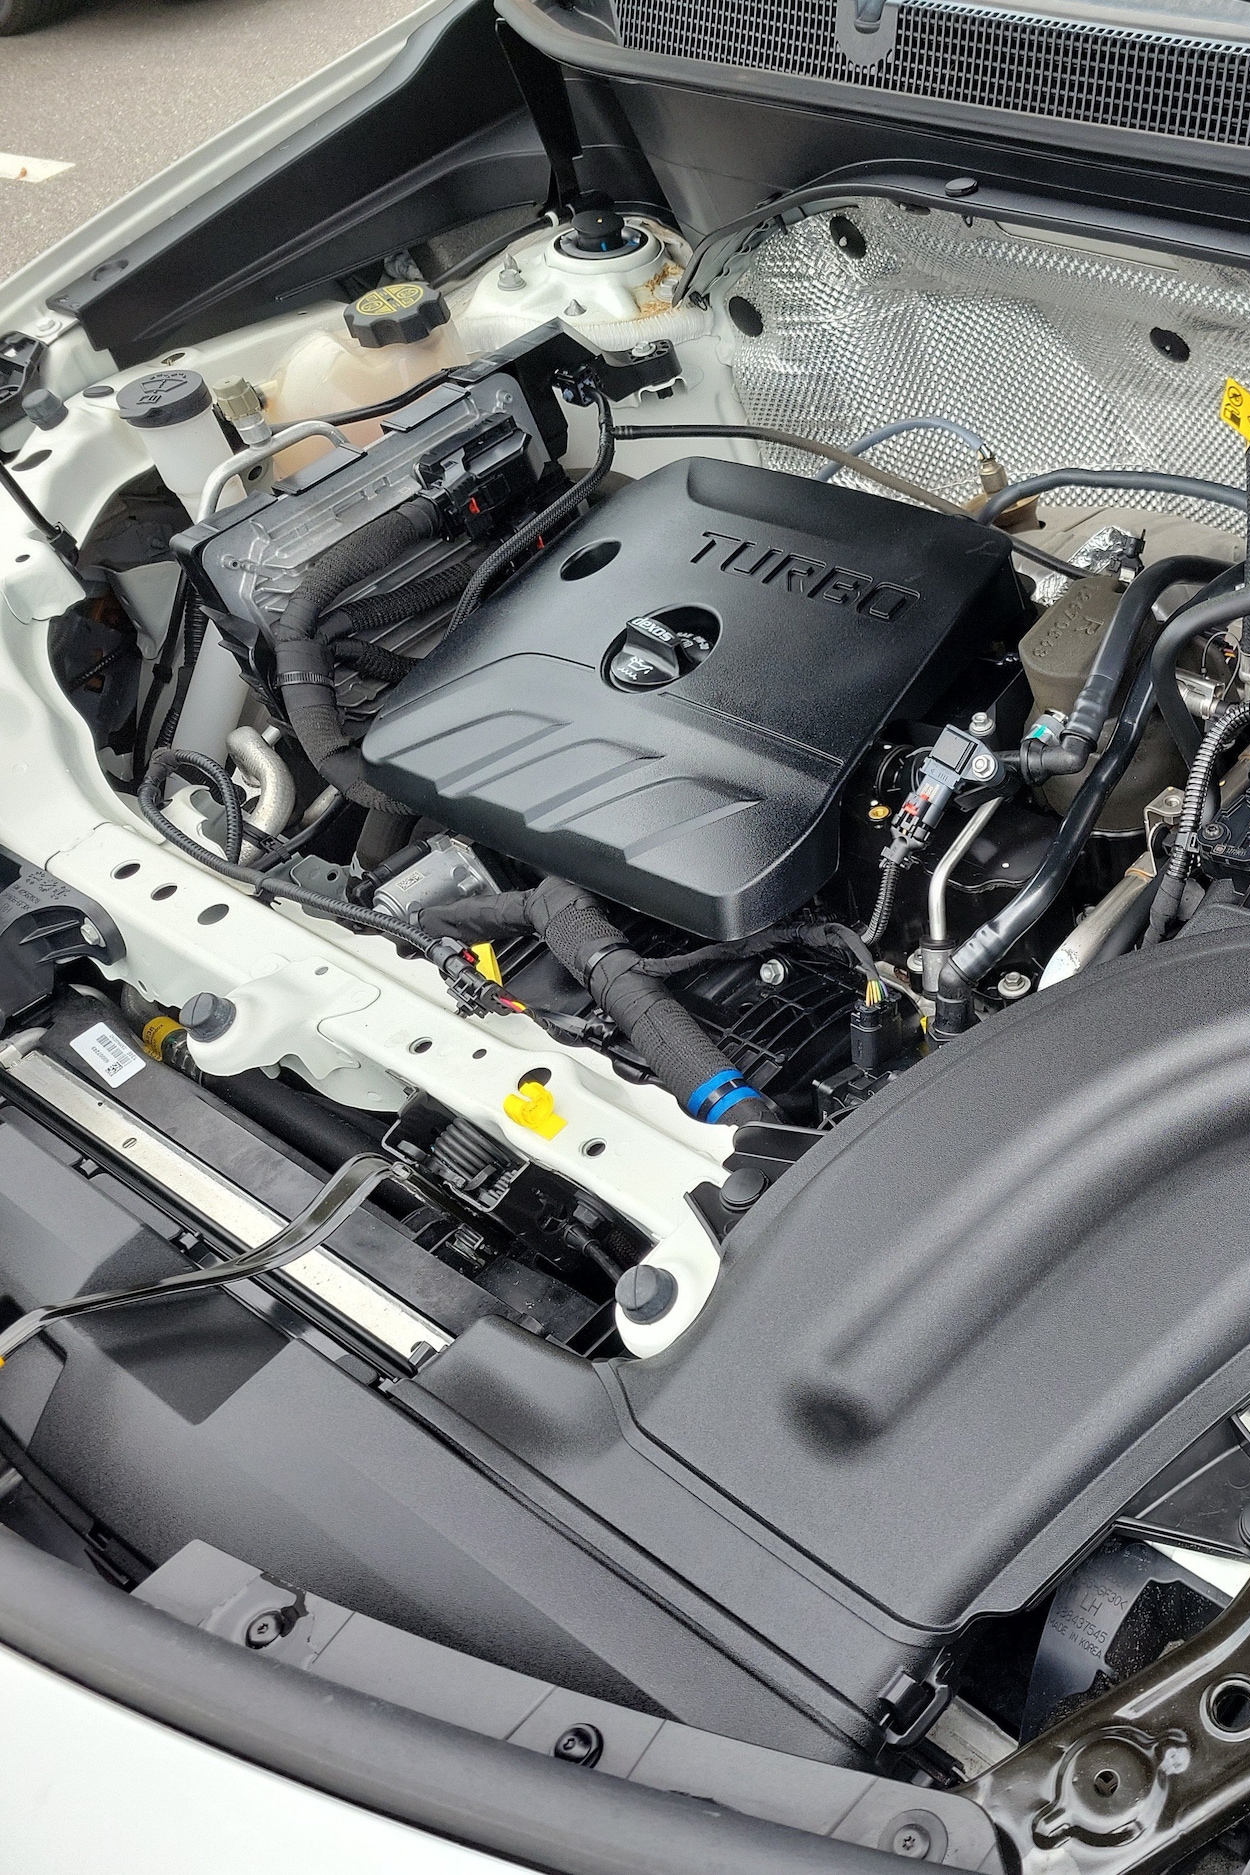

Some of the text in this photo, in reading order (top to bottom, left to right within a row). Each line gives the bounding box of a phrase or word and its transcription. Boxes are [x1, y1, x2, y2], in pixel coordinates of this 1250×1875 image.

[690, 531, 920, 622] TURBO
[631, 617, 676, 642] dexos
[1080, 1592, 1103, 1616] LH
[1069, 1631, 1079, 1642] IN
[1079, 1637, 1102, 1658] KOREA
